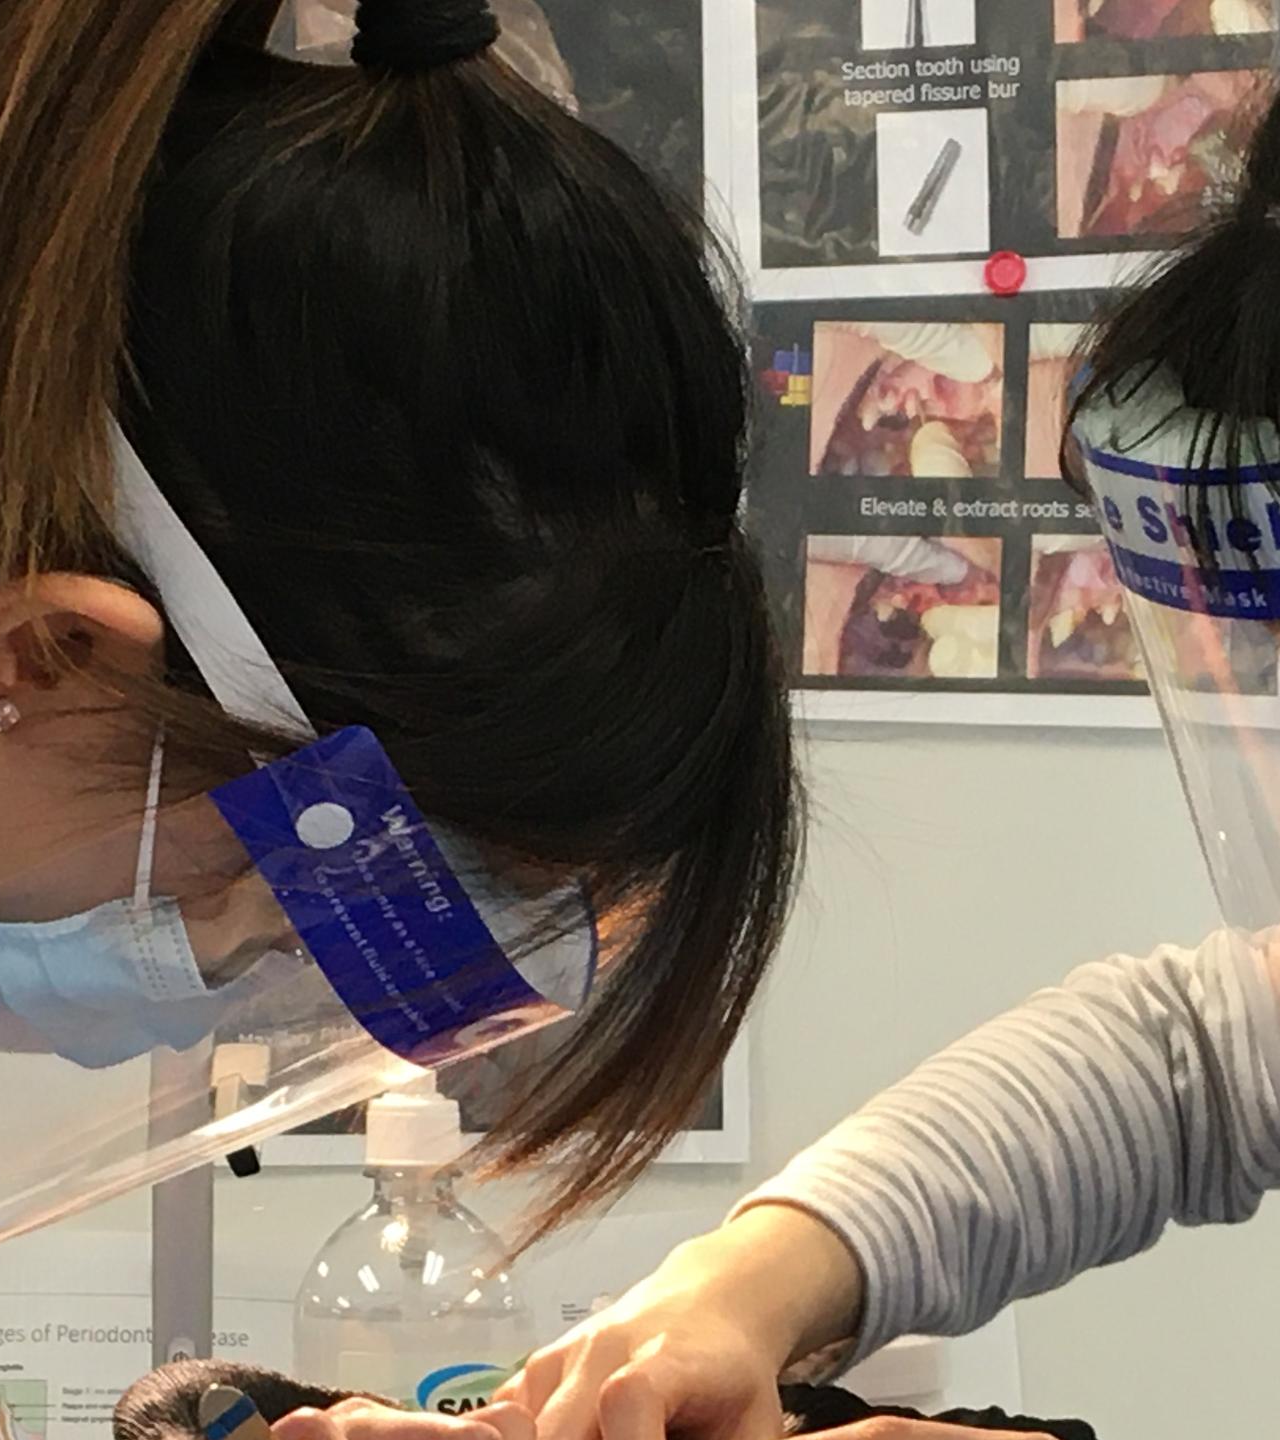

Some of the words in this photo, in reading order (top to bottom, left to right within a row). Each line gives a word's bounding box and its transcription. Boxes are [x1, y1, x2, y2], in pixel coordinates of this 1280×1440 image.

[841, 62, 910, 80] Section
[915, 57, 964, 76] tooth
[971, 54, 1021, 76] using
[844, 84, 915, 107] tapered
[921, 83, 981, 102] fissure
[988, 80, 1020, 98] bur
[860, 498, 927, 516] Elevate
[932, 498, 947, 516] &
[953, 500, 1018, 518] extract
[1022, 501, 1069, 518] roots
[380, 803, 453, 923] Warning:
[30, 1323, 51, 1343] of
